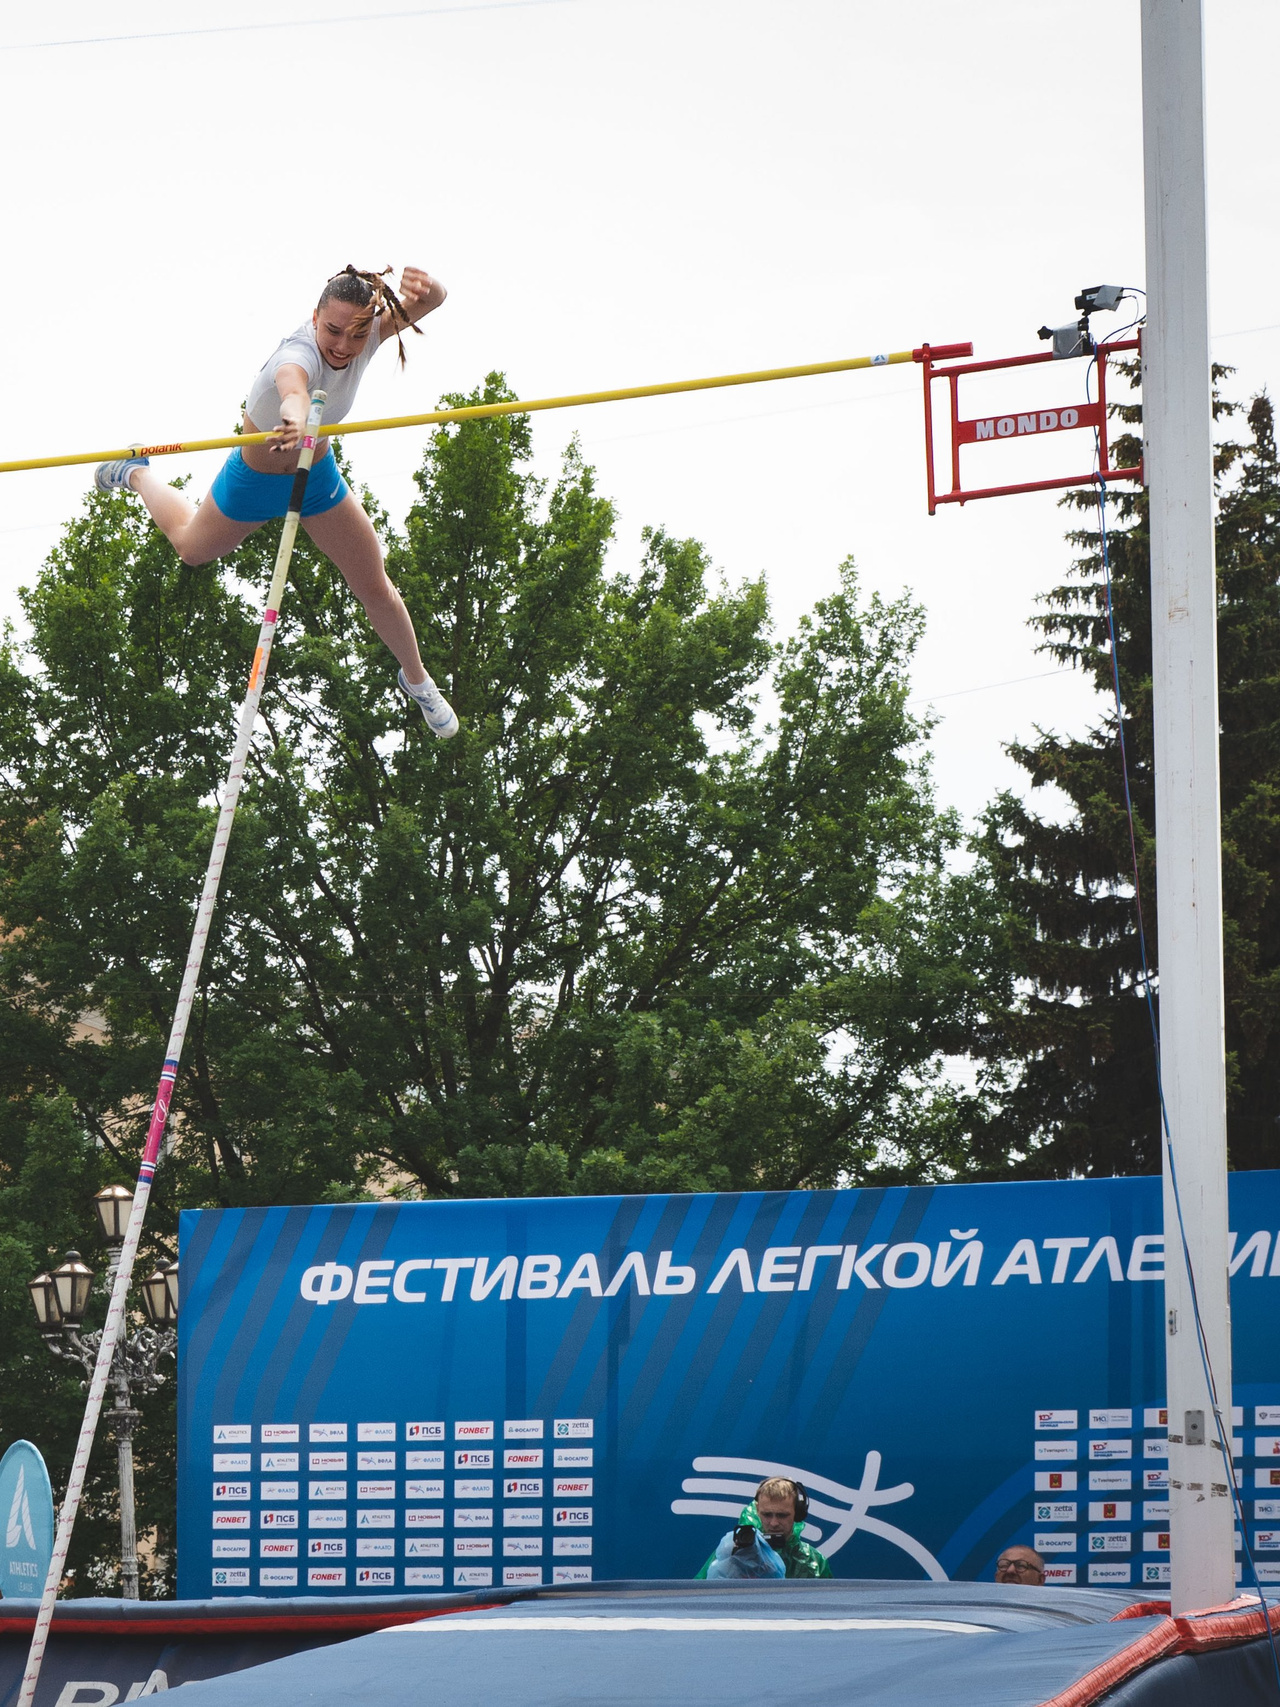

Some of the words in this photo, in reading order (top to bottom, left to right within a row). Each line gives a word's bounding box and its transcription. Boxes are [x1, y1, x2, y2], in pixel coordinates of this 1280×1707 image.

[976, 409, 1079, 440] MONDO
[140, 443, 183, 457] polanik
[300, 1251, 696, 1305] ФЕСТИВАЛЬ
[707, 1228, 984, 1294] ЛЕГКОЙ
[991, 1230, 1280, 1286] АТЛЕИ
[422, 1426, 441, 1435] ПСБ
[470, 1455, 490, 1463] ПСБ
[228, 1486, 248, 1494] ПСБ
[520, 1483, 540, 1491] ПСБ
[276, 1515, 295, 1523] ПСБ
[569, 1512, 589, 1520] ПСБ
[324, 1543, 343, 1551] ПСБ
[9, 1561, 38, 1578] ATHLETICS
[372, 1572, 391, 1580] ПСБ
